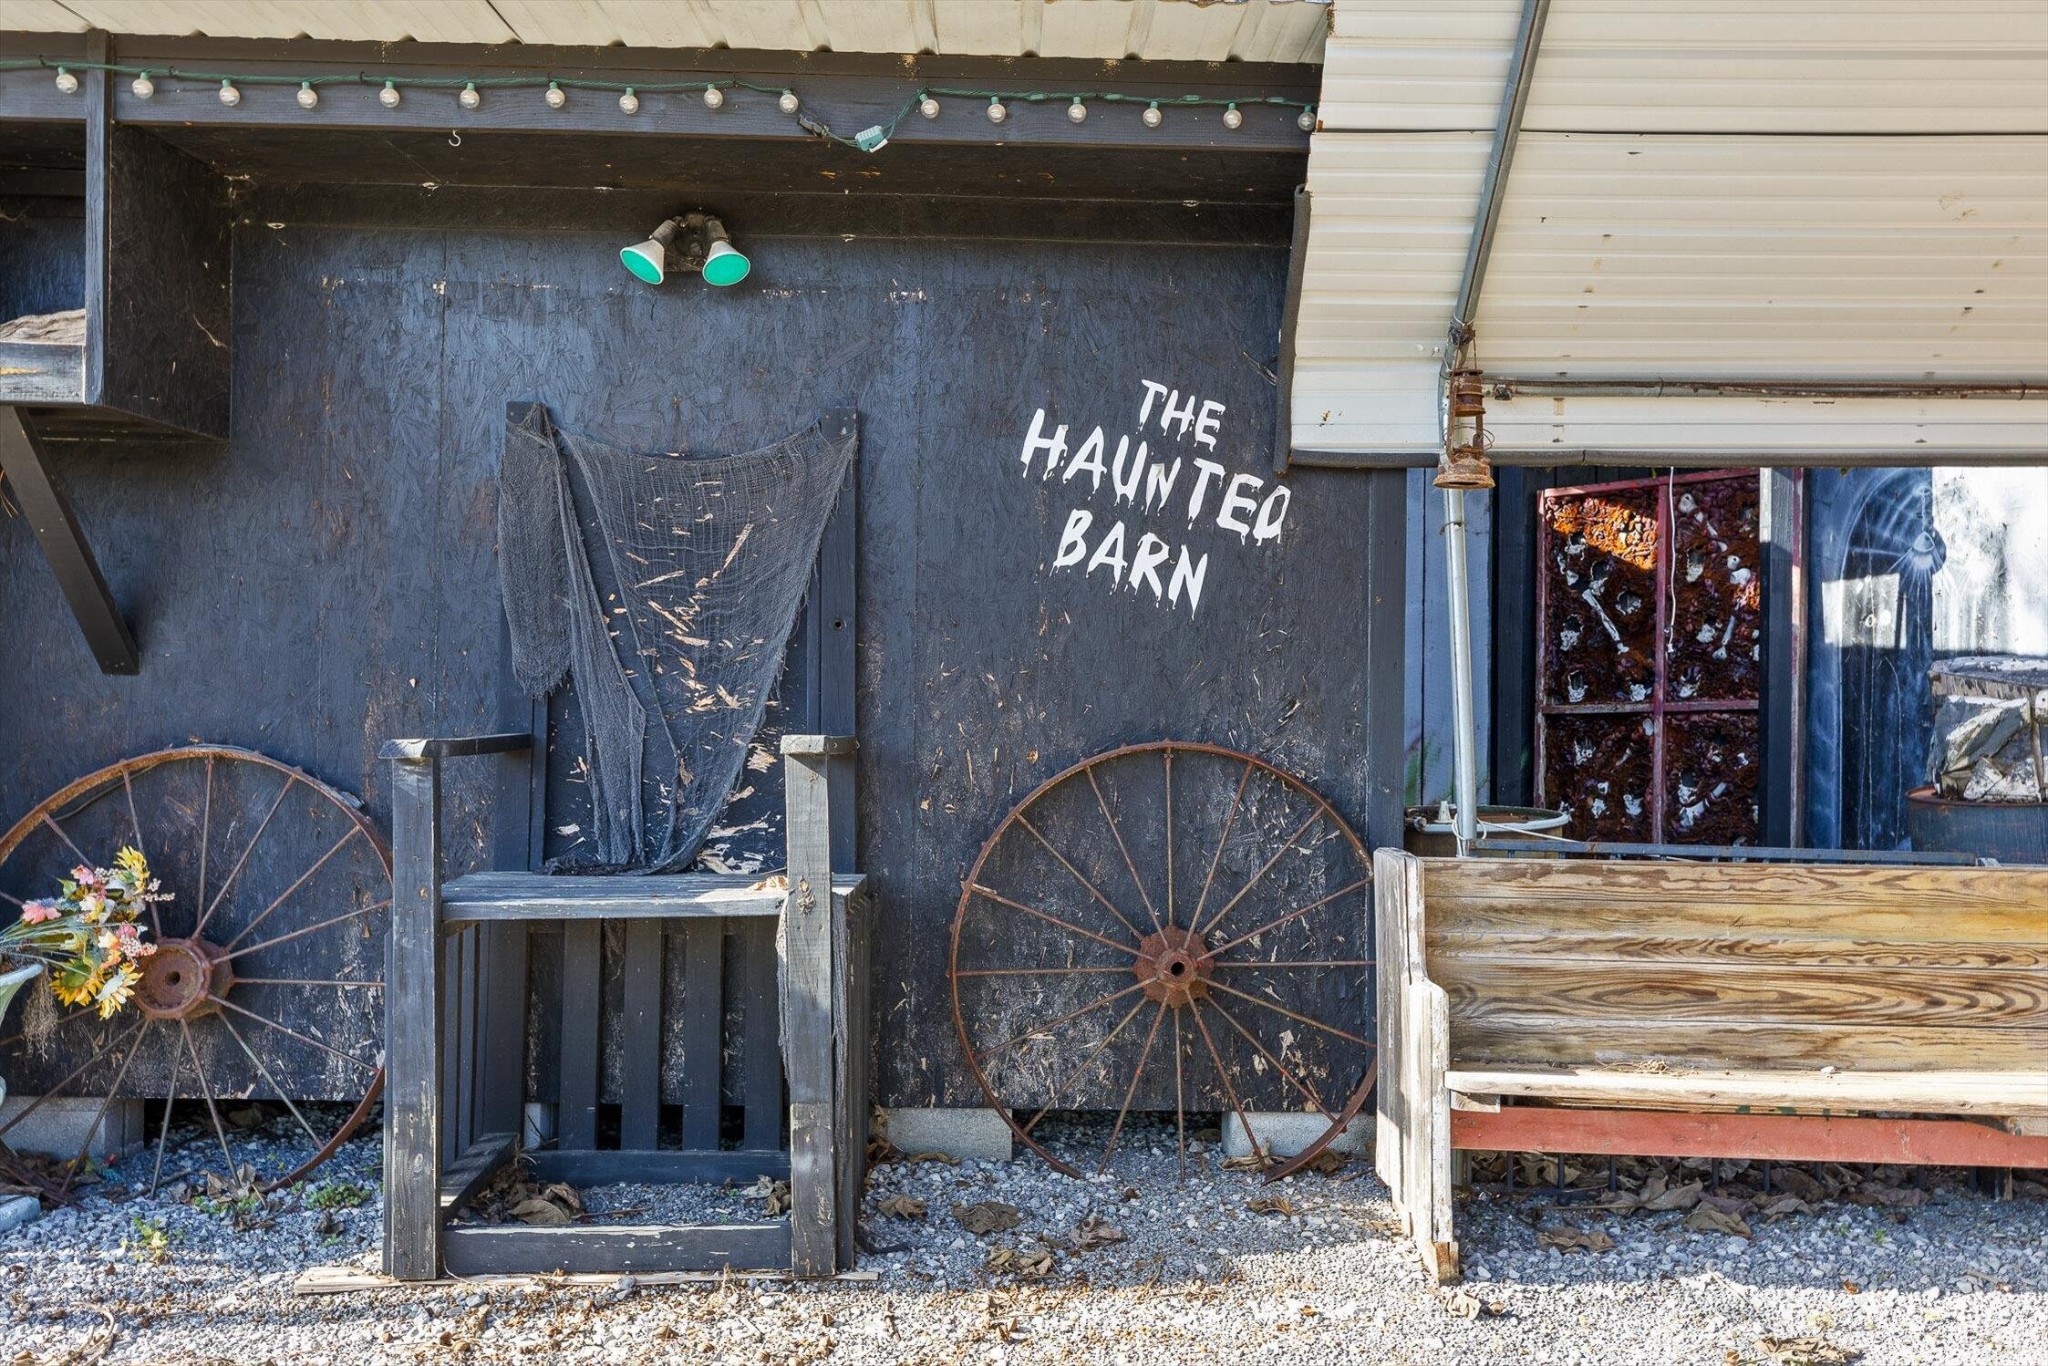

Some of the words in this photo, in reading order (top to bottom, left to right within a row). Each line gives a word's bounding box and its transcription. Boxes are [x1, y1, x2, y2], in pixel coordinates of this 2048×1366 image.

[1138, 380, 1226, 452] THE
[1020, 408, 1291, 546] HAUNTED
[1050, 509, 1207, 620] BARN
